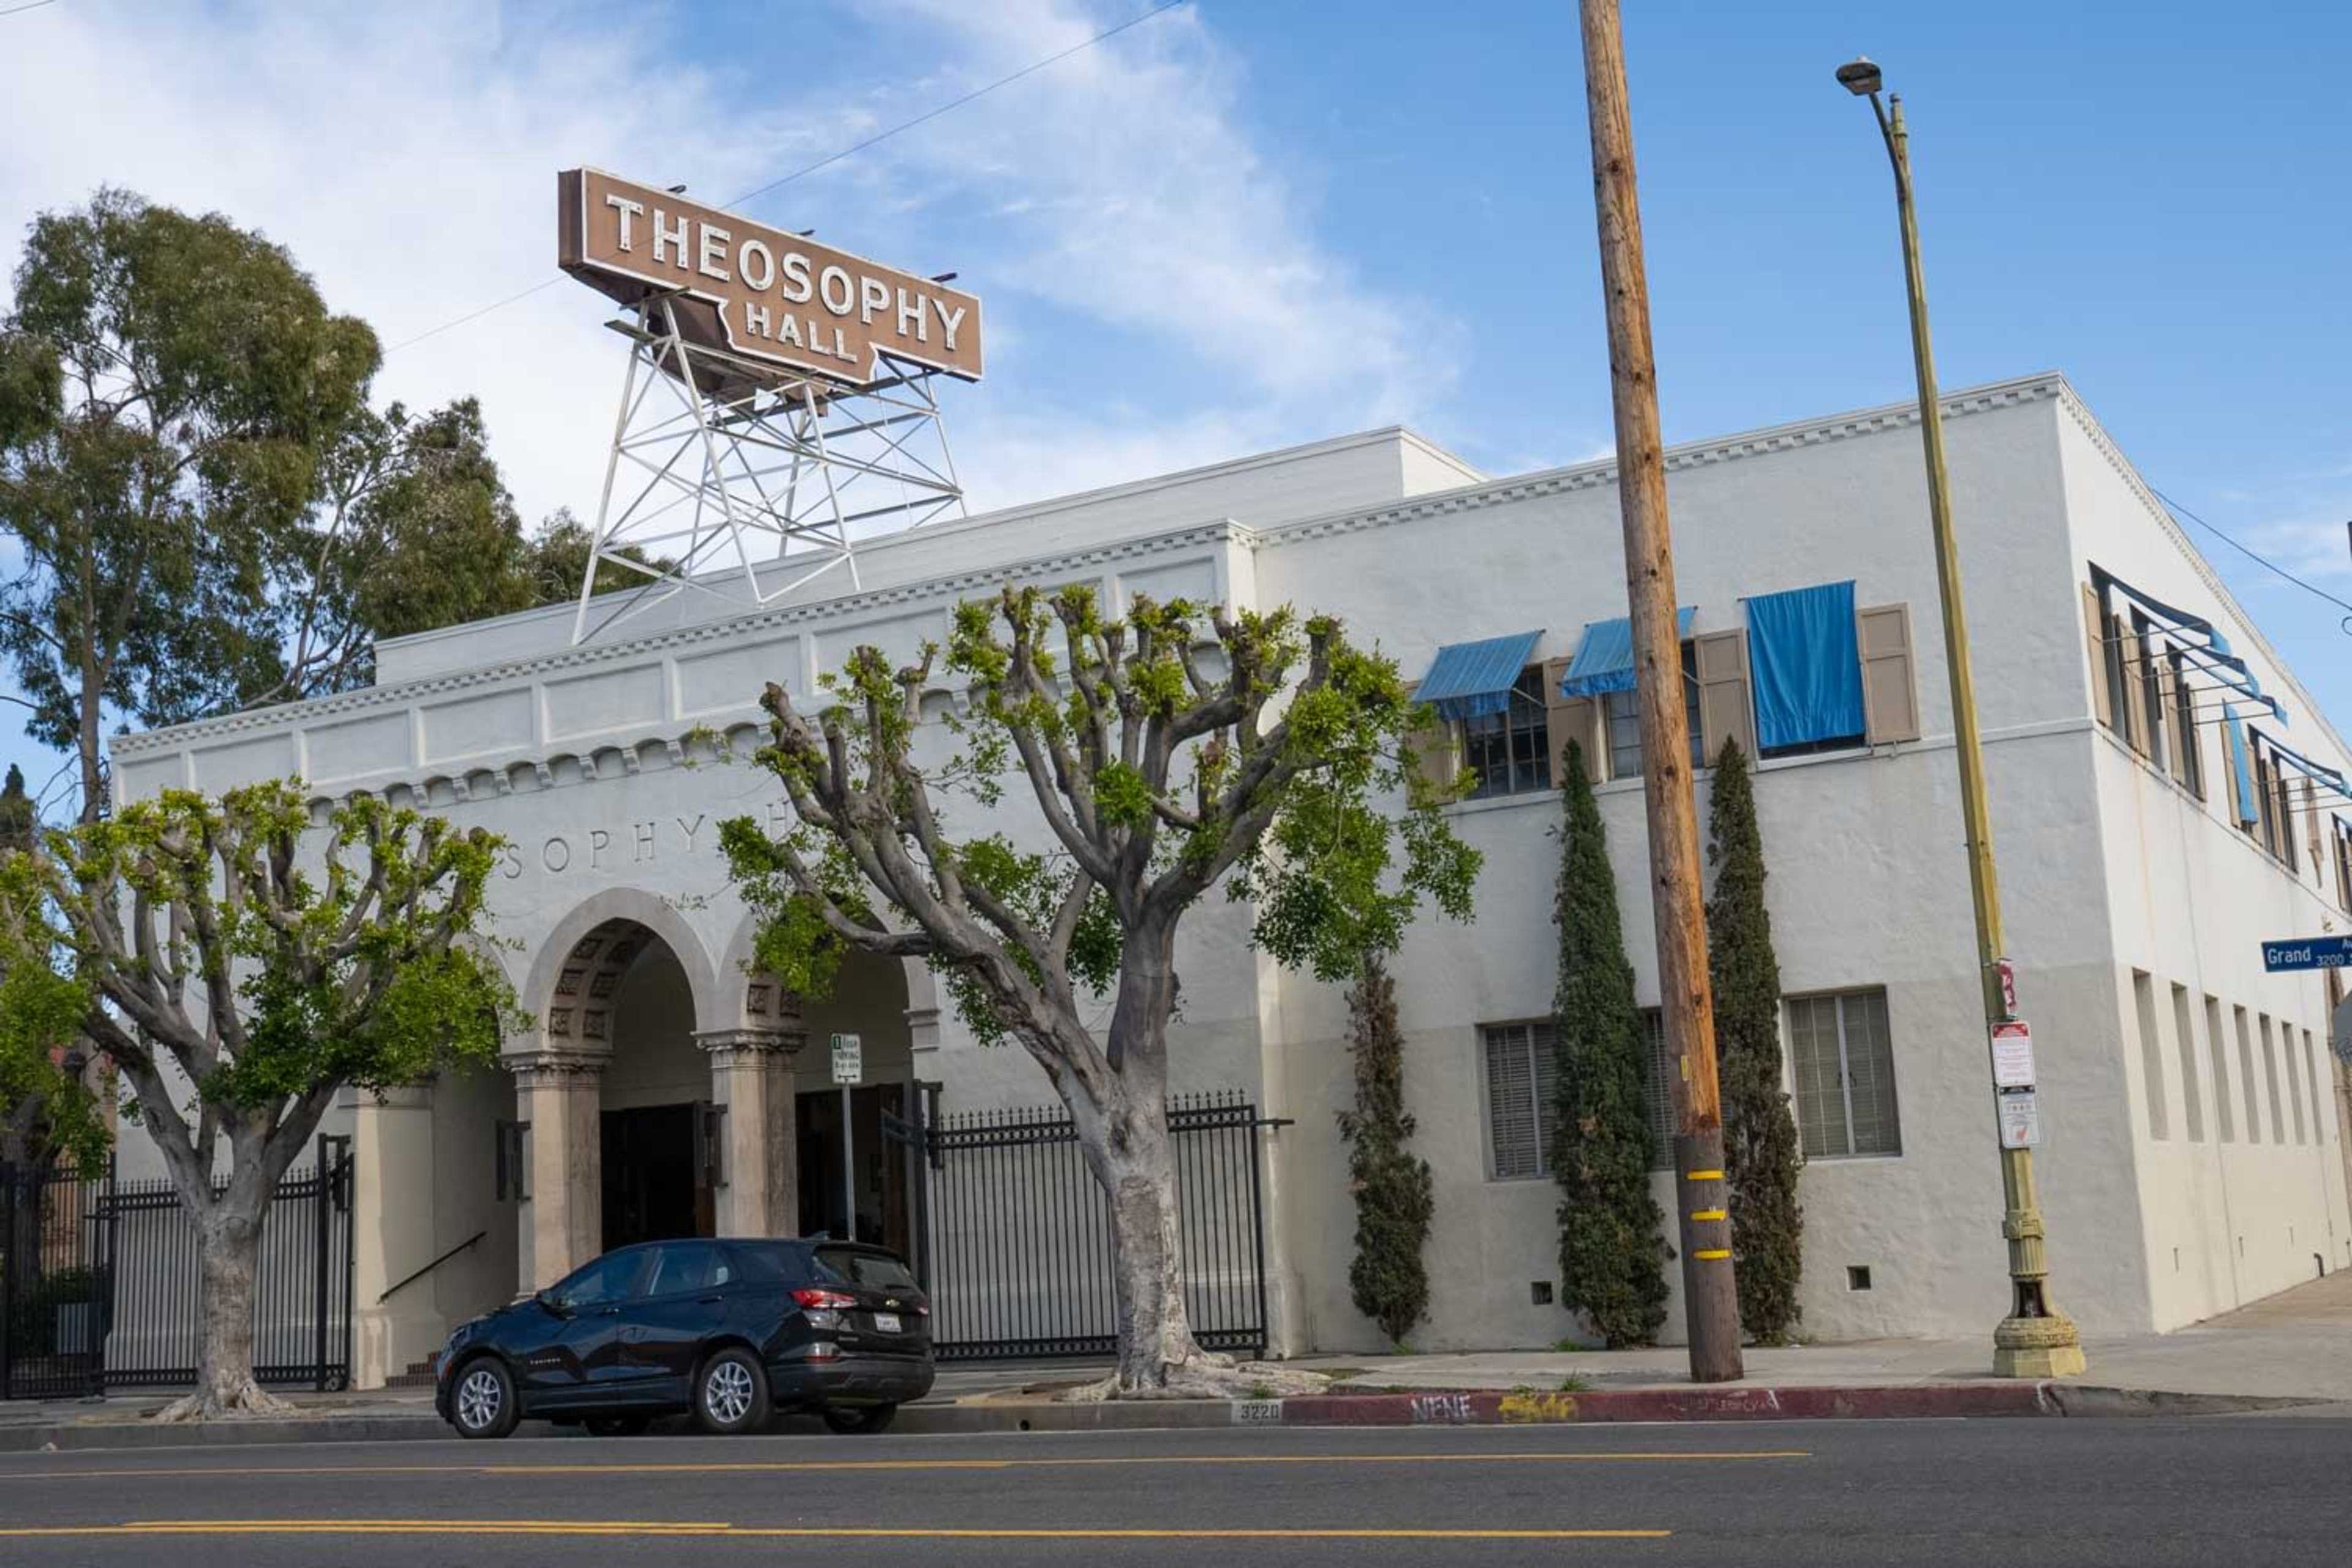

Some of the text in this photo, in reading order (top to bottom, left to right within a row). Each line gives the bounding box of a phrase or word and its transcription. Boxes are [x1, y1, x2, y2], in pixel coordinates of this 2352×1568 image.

[606, 194, 966, 351] THEOSOPHY
[745, 301, 858, 364] HALL
[2267, 946, 2311, 965] Grand
[2316, 953, 2345, 967] 3200
[1241, 1404, 1278, 1419] 3220
